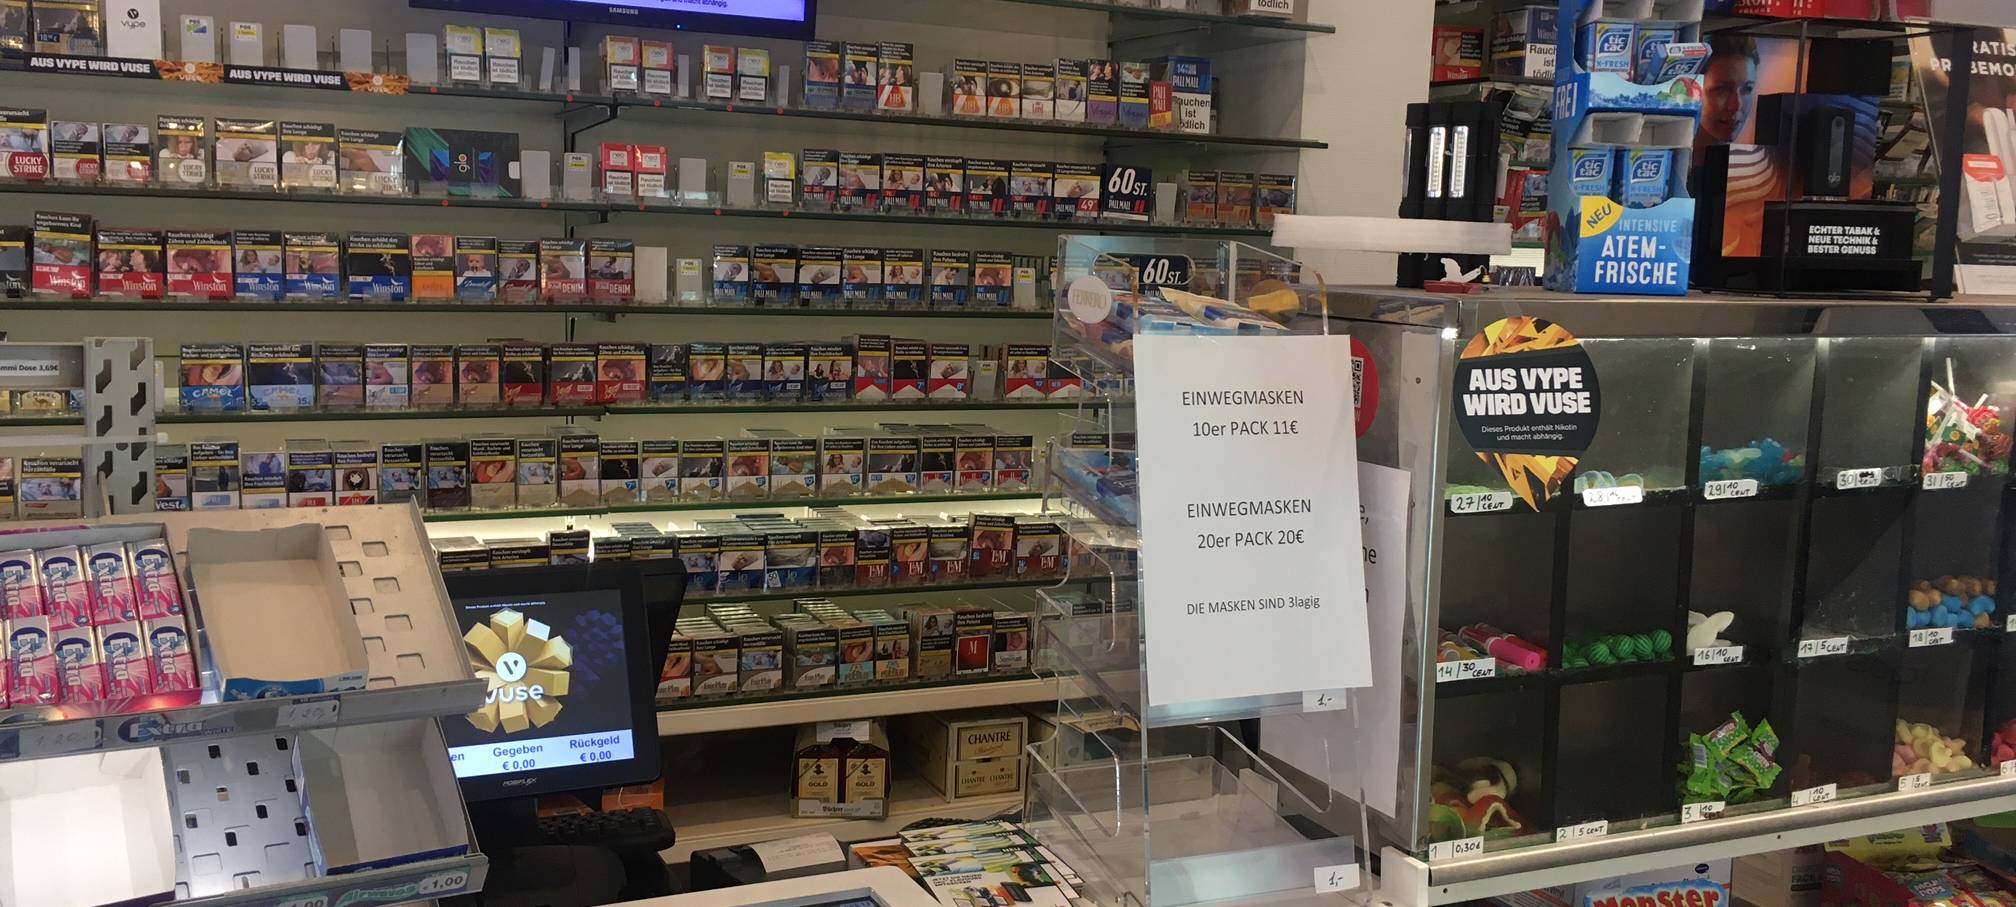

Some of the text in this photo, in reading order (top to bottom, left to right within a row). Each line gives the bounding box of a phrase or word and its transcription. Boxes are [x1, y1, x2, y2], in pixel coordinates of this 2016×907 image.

[608, 6, 640, 16] SAMSUNG
[1608, 34, 1627, 45] tic
[1603, 42, 1625, 53] tac
[30, 57, 55, 69] AUS
[55, 58, 86, 71] VYPE
[88, 60, 119, 73] WIRD
[119, 62, 151, 75] VUSE
[1543, 57, 1555, 67] ist
[229, 69, 253, 81] AUS
[253, 70, 282, 83] VYPE
[283, 72, 312, 84] WIRD
[312, 74, 341, 86] VUSE
[1173, 76, 1186, 89] PALL
[1184, 108, 1197, 118] ist
[14, 155, 43, 165] LUCKY
[453, 152, 471, 173] glo
[1583, 159, 1602, 170] tic
[1641, 159, 1660, 170] tic
[13, 163, 43, 175] STRIKE
[253, 166, 275, 174] LUCKY
[1578, 167, 1599, 178] tac
[1636, 167, 1657, 178] tac
[1108, 167, 1149, 197] 60 ST.
[1585, 202, 1613, 230] NEU
[1617, 219, 1678, 234] INTENSIVE
[1808, 225, 1881, 236] ECHTER TABAK &
[1808, 235, 1879, 246] NEUE TECHNIK &
[1600, 235, 1667, 260] ATEM-
[1807, 245, 1877, 256] BESTER GENUSS
[1142, 258, 1182, 285] 60 ST.
[1593, 260, 1678, 286] FRISCHE
[48, 274, 87, 290] Winston
[121, 279, 158, 292] Winston
[193, 279, 227, 292] Winston
[248, 281, 280, 292] Winston
[304, 280, 336, 292] Winston
[372, 282, 404, 294] Winston
[562, 281, 585, 295] DENIM
[609, 282, 632, 295] DENIM
[18, 363, 36, 372] Dose
[1469, 366, 1584, 392] AUS VYPE
[192, 386, 234, 400] CAMEL
[1182, 390, 1304, 407] EINWEGMASKEN
[1462, 391, 1592, 418] WIRD VUSE
[1193, 419, 1299, 437] 10er PACK 11€
[1481, 423, 1578, 434] Dieses Produkt enthält Nikotin
[1496, 432, 1564, 442] und macht abhängig.
[1187, 498, 1312, 519] EINWEGMASKEN
[1197, 528, 1305, 550] 20er PACK 20€
[1186, 594, 1321, 616] DIE MASKEN SIND 3lagig
[492, 743, 544, 759] Gegeben
[569, 734, 621, 750] Rückgeld
[501, 760, 511, 771] €
[579, 752, 588, 763] €
[501, 777, 538, 788] POSIFLEX
